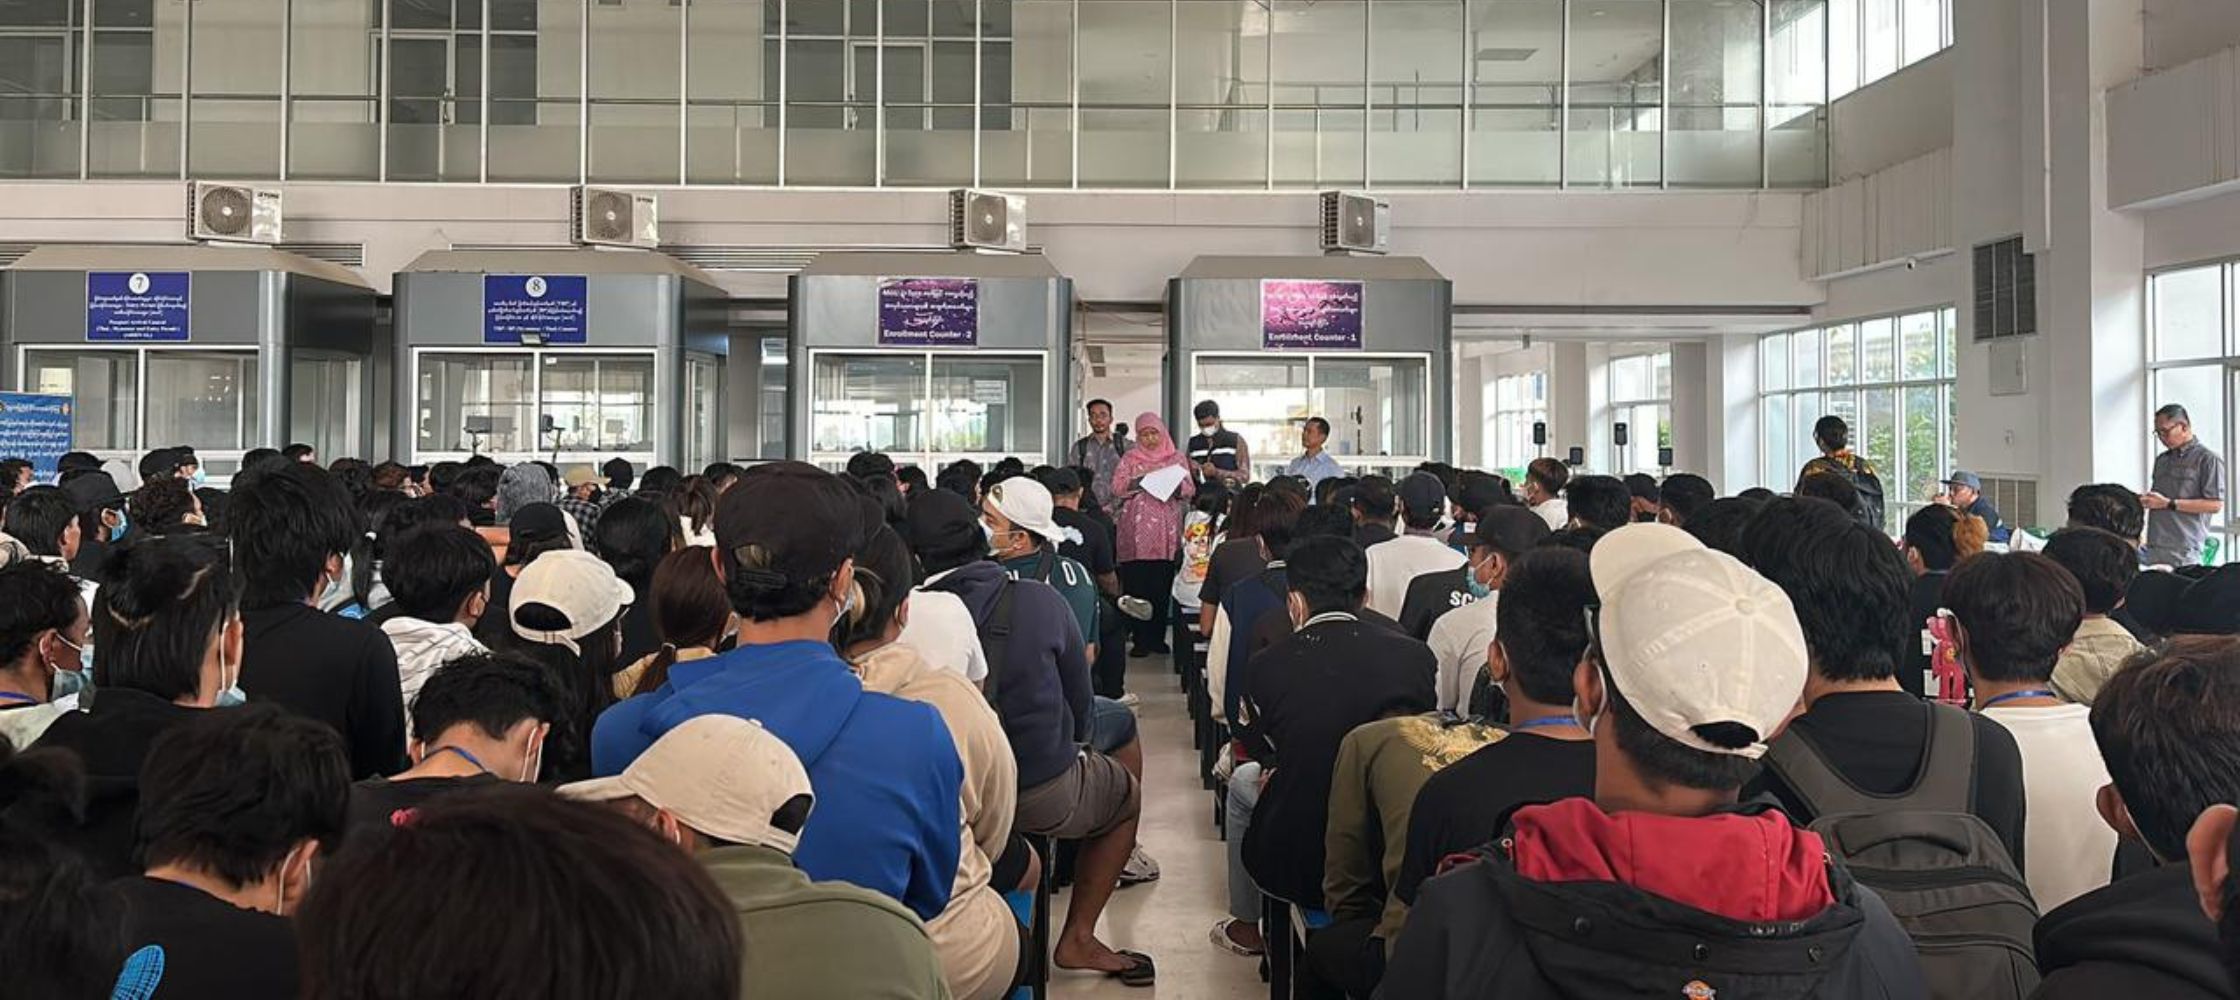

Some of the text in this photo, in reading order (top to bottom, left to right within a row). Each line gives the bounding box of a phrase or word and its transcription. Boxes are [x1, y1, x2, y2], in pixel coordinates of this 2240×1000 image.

[136, 277, 144, 289] 7
[533, 279, 540, 291] 8
[883, 329, 928, 338] Enrollment
[929, 329, 961, 338] Counter
[1314, 333, 1346, 341] Counter
